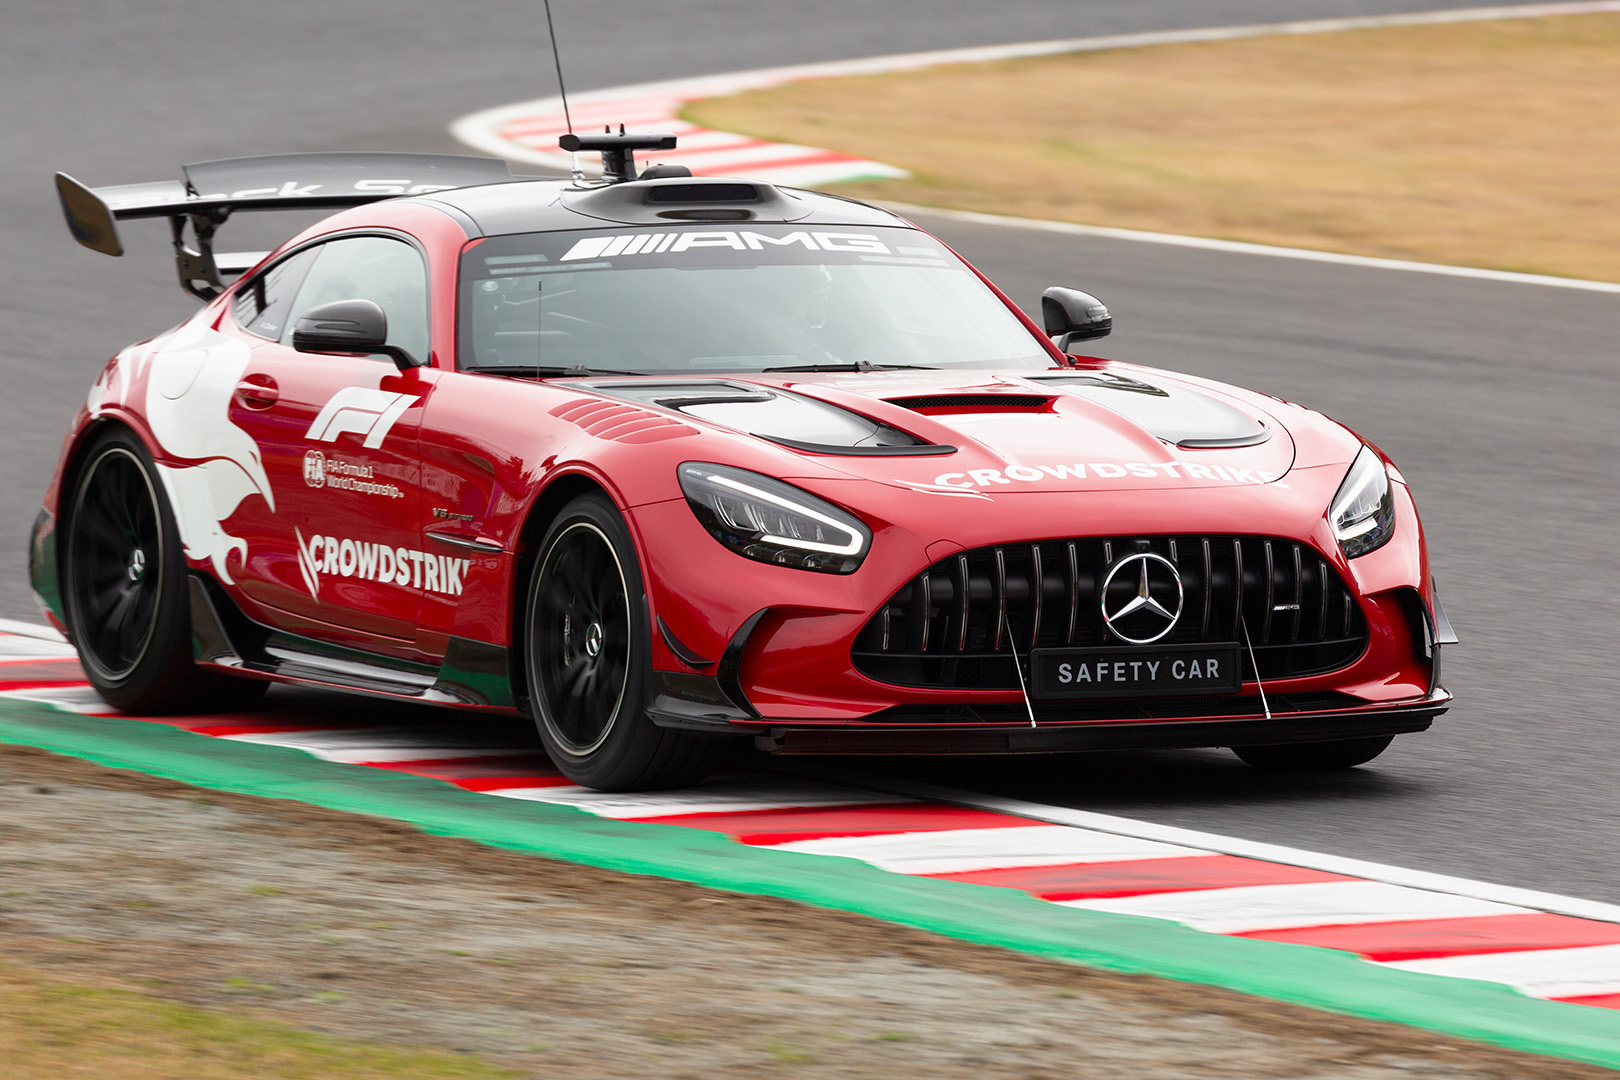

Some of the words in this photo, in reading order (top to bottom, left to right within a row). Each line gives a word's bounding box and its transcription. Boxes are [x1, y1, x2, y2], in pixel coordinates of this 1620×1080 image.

[671, 231, 891, 255] AMG
[327, 459, 339, 473] FIA
[339, 462, 368, 478] Formula
[934, 462, 1291, 490] CROWDSTRIKE
[327, 475, 348, 490] World
[348, 478, 399, 499] Championship
[310, 534, 470, 596] CROWDSTRIK
[1058, 661, 1160, 684] SAFETY
[1171, 657, 1220, 679] CAR
